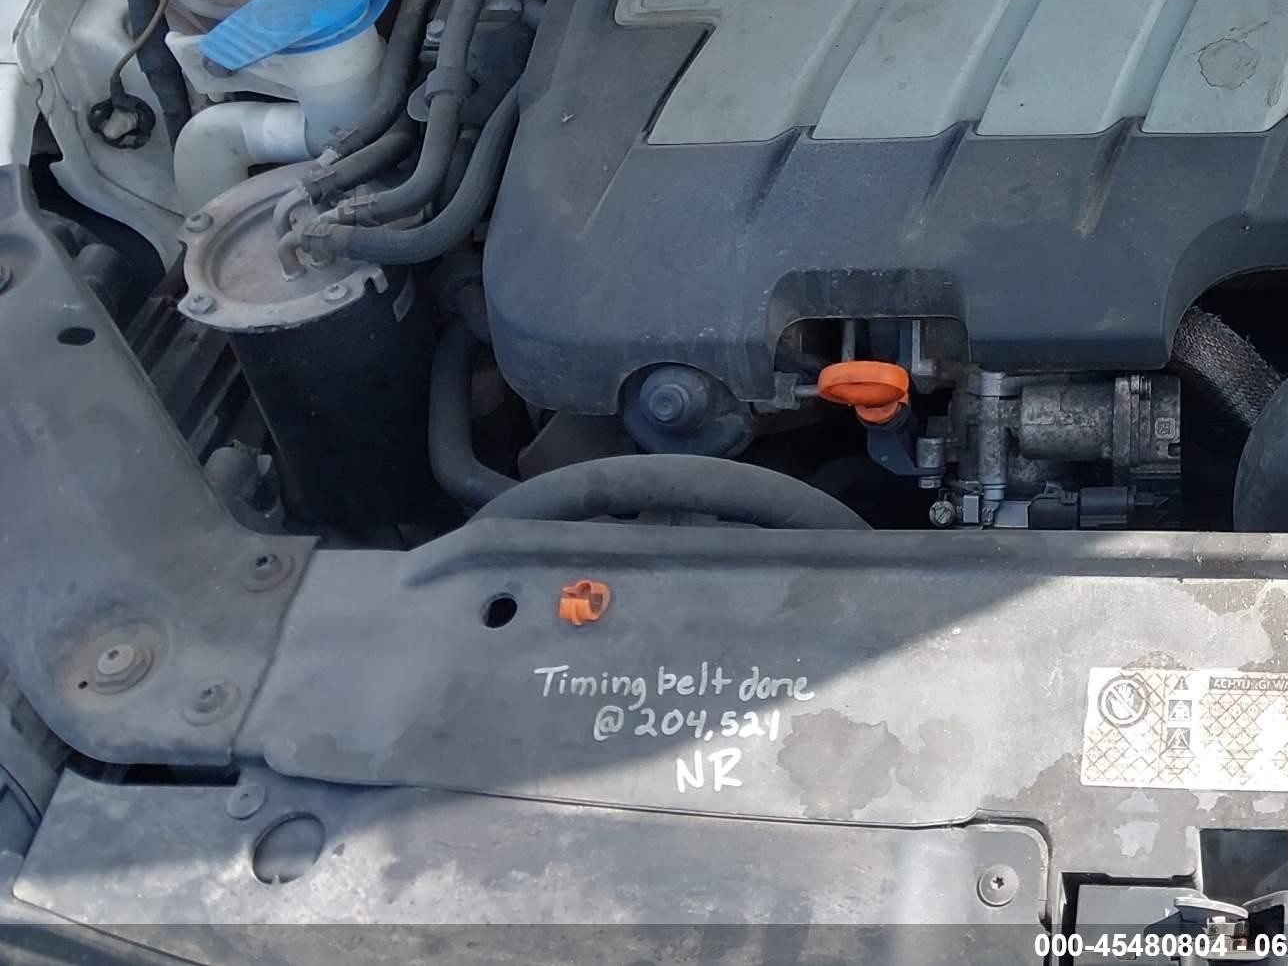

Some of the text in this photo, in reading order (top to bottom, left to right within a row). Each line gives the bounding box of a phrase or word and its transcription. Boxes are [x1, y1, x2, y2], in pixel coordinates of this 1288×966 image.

[534, 662, 816, 710] Timing belt done
[675, 747, 743, 794] NR
